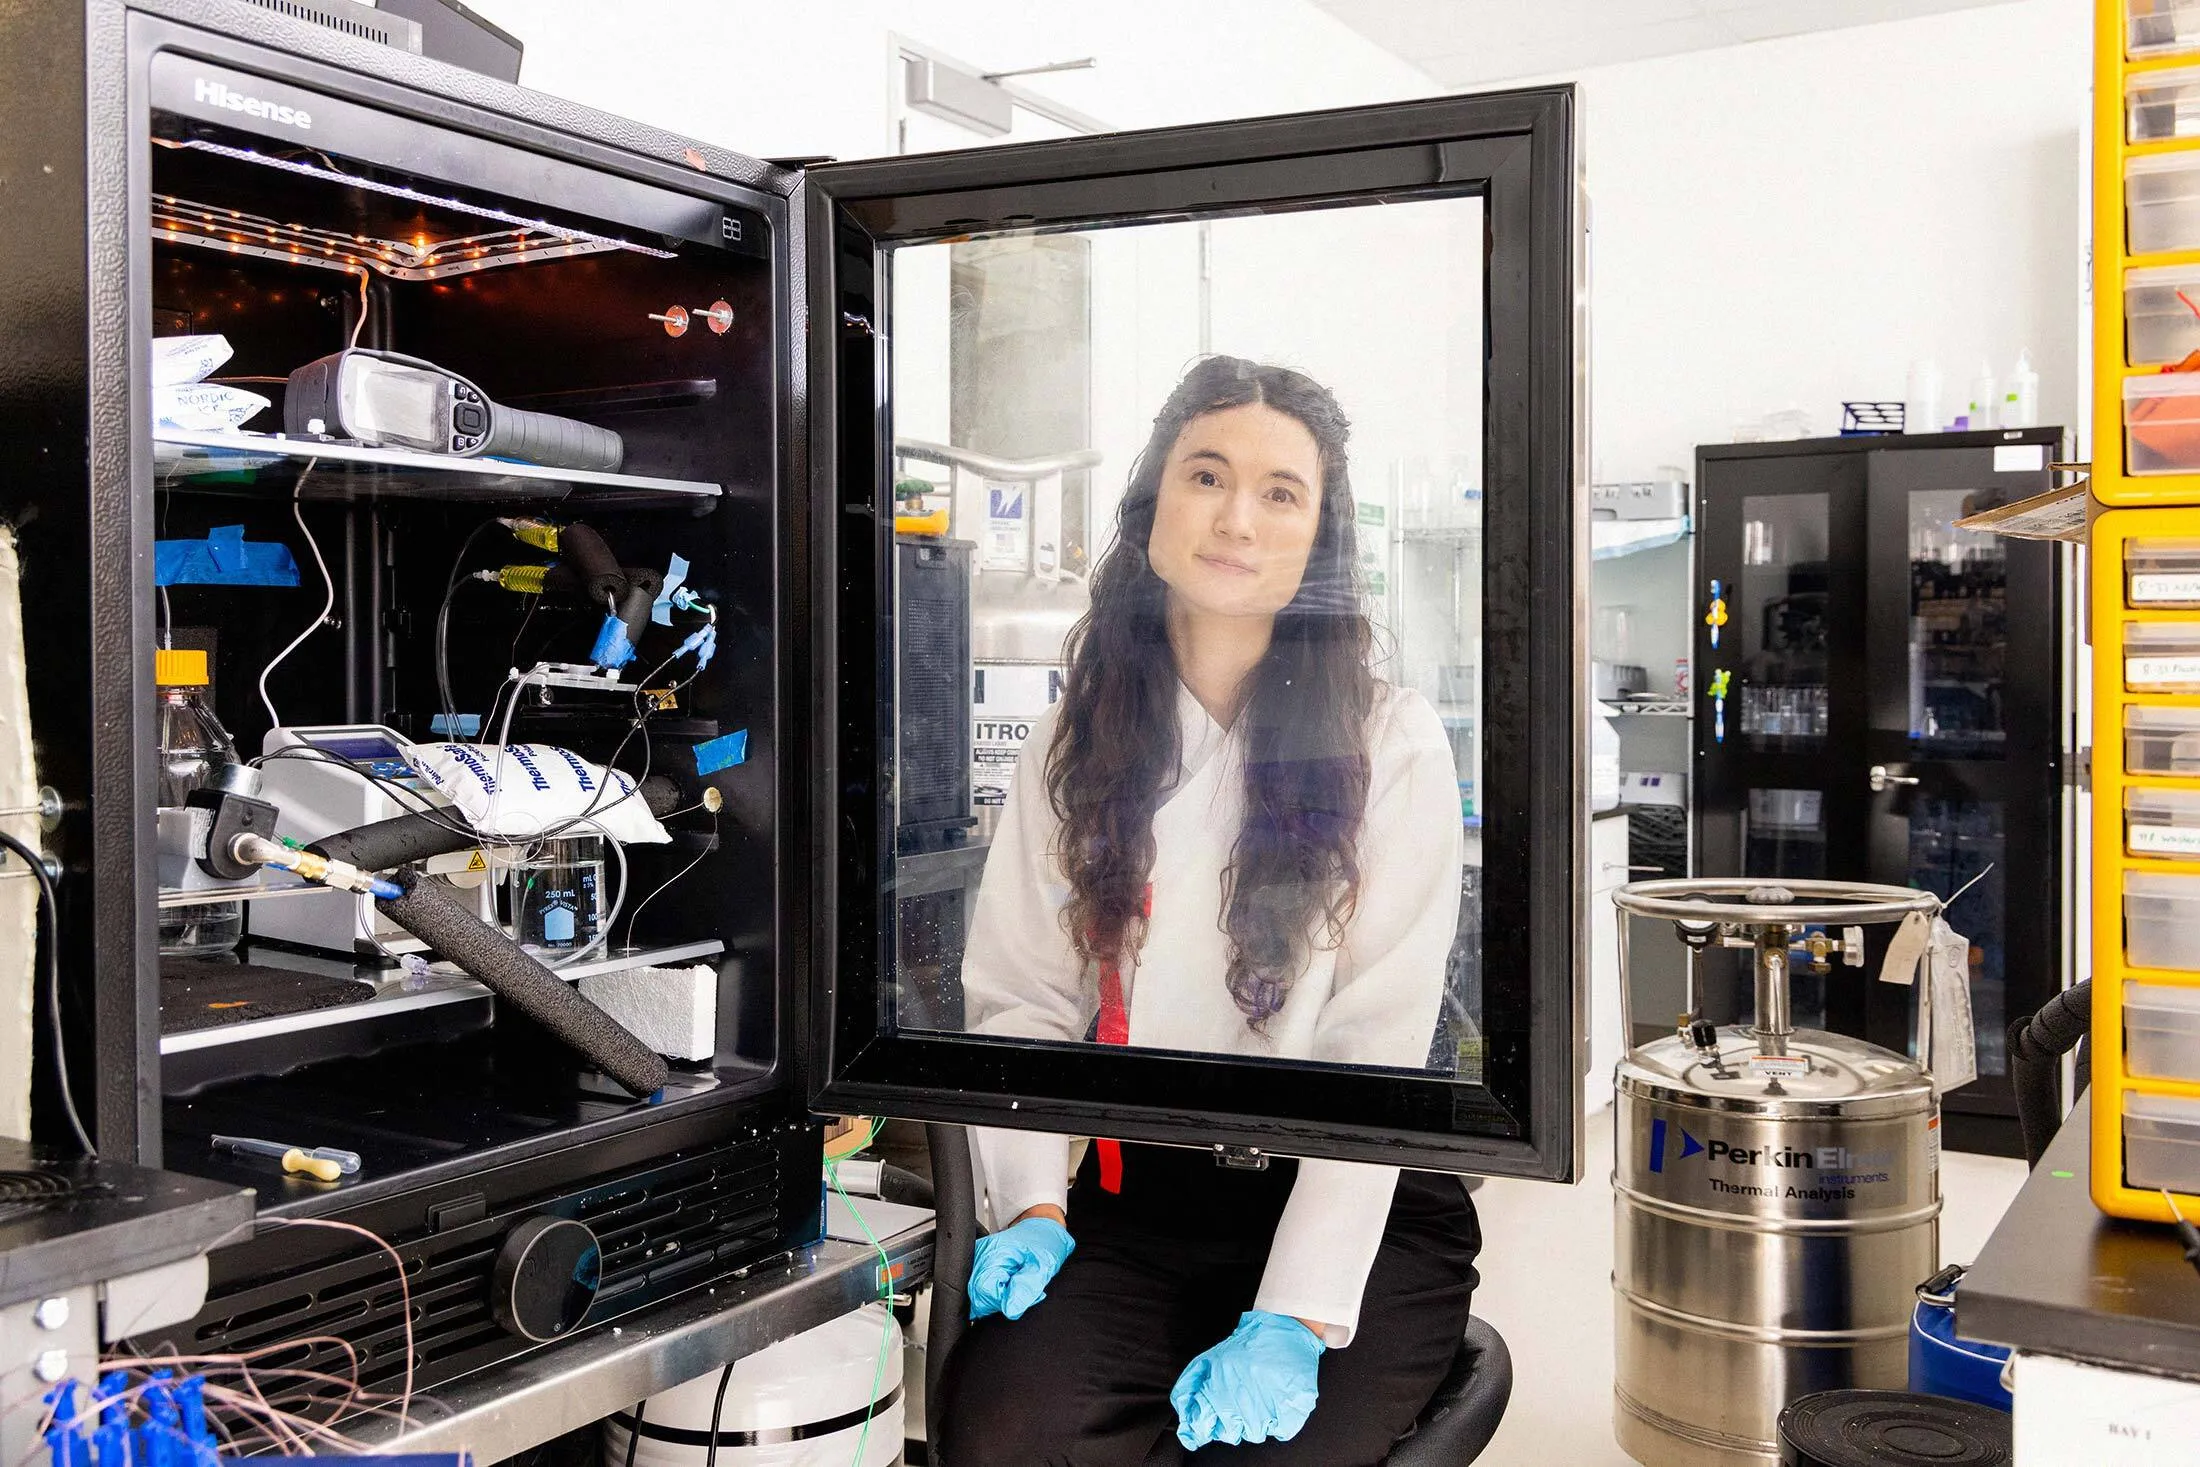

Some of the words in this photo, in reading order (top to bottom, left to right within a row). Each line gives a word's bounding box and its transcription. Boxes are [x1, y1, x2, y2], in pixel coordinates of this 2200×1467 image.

[194, 78, 312, 129] Hisense
[177, 391, 235, 407] NORDIC
[545, 890, 561, 899] 250
[563, 889, 576, 898] mL
[1709, 1178, 1779, 1198] Thermal
[1785, 1186, 1856, 1201] Analysis
